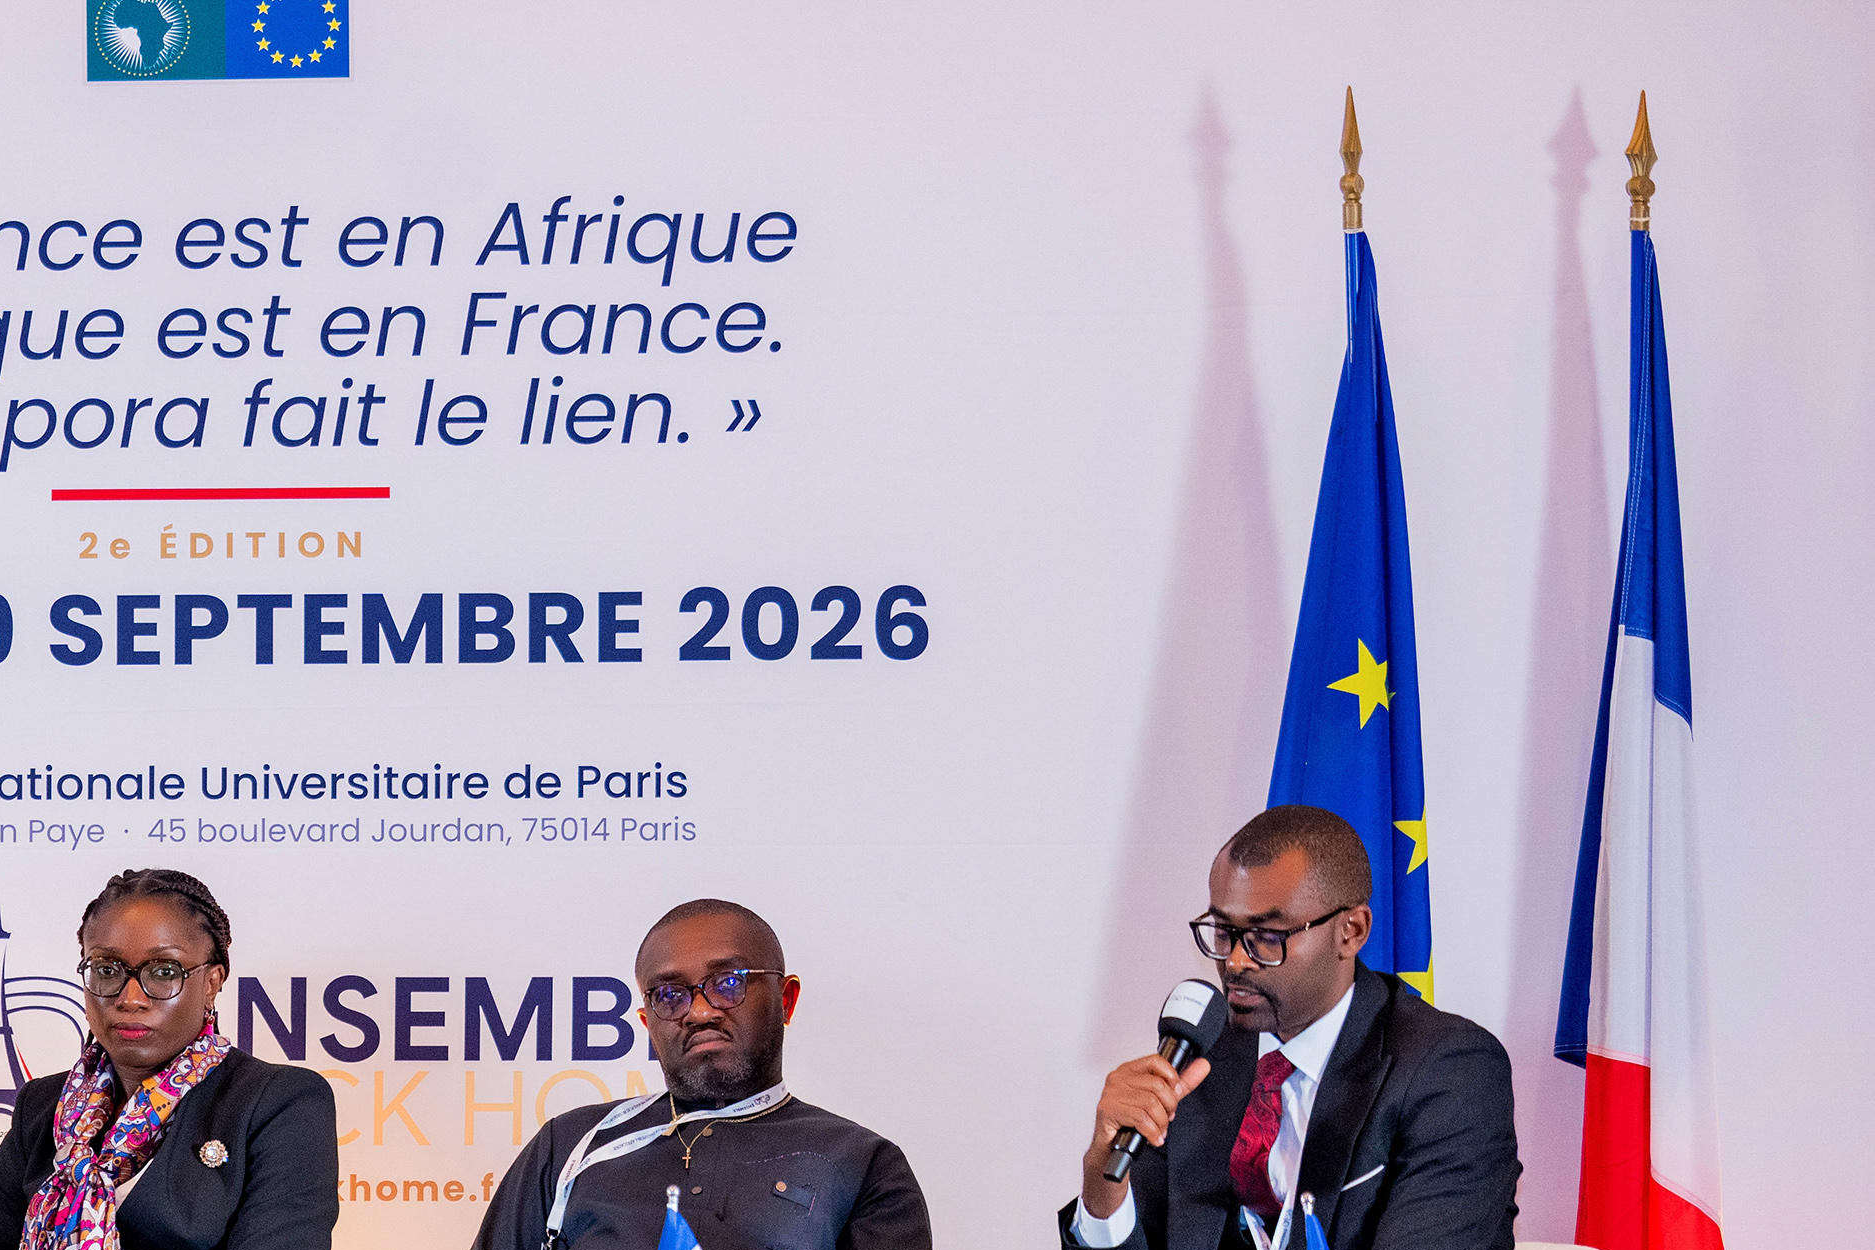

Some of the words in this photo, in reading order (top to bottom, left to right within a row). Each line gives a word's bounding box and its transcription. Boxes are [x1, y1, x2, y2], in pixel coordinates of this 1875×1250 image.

[175, 206, 309, 269] est
[339, 216, 444, 267] en
[476, 195, 797, 286] Afrique
[158, 296, 291, 361] est
[320, 306, 428, 358] en
[461, 292, 781, 356] France.
[243, 378, 386, 447] fait
[415, 379, 487, 446] le
[520, 376, 689, 444] lien.
[79, 532, 130, 559] 2e
[161, 524, 361, 558] ÉDITION
[50, 591, 642, 666] SEPTEMBRE
[679, 585, 929, 661] 2026
[202, 763, 489, 799] Universitaire
[504, 764, 561, 799] de
[578, 762, 687, 798] Paris
[29, 820, 104, 850] Paye
[148, 819, 186, 842] 45
[198, 818, 359, 842] boulevard
[372, 818, 511, 846] Jourdan,
[522, 817, 610, 841] 75014
[622, 816, 696, 841] Paris
[237, 974, 661, 1062] NSEMB
